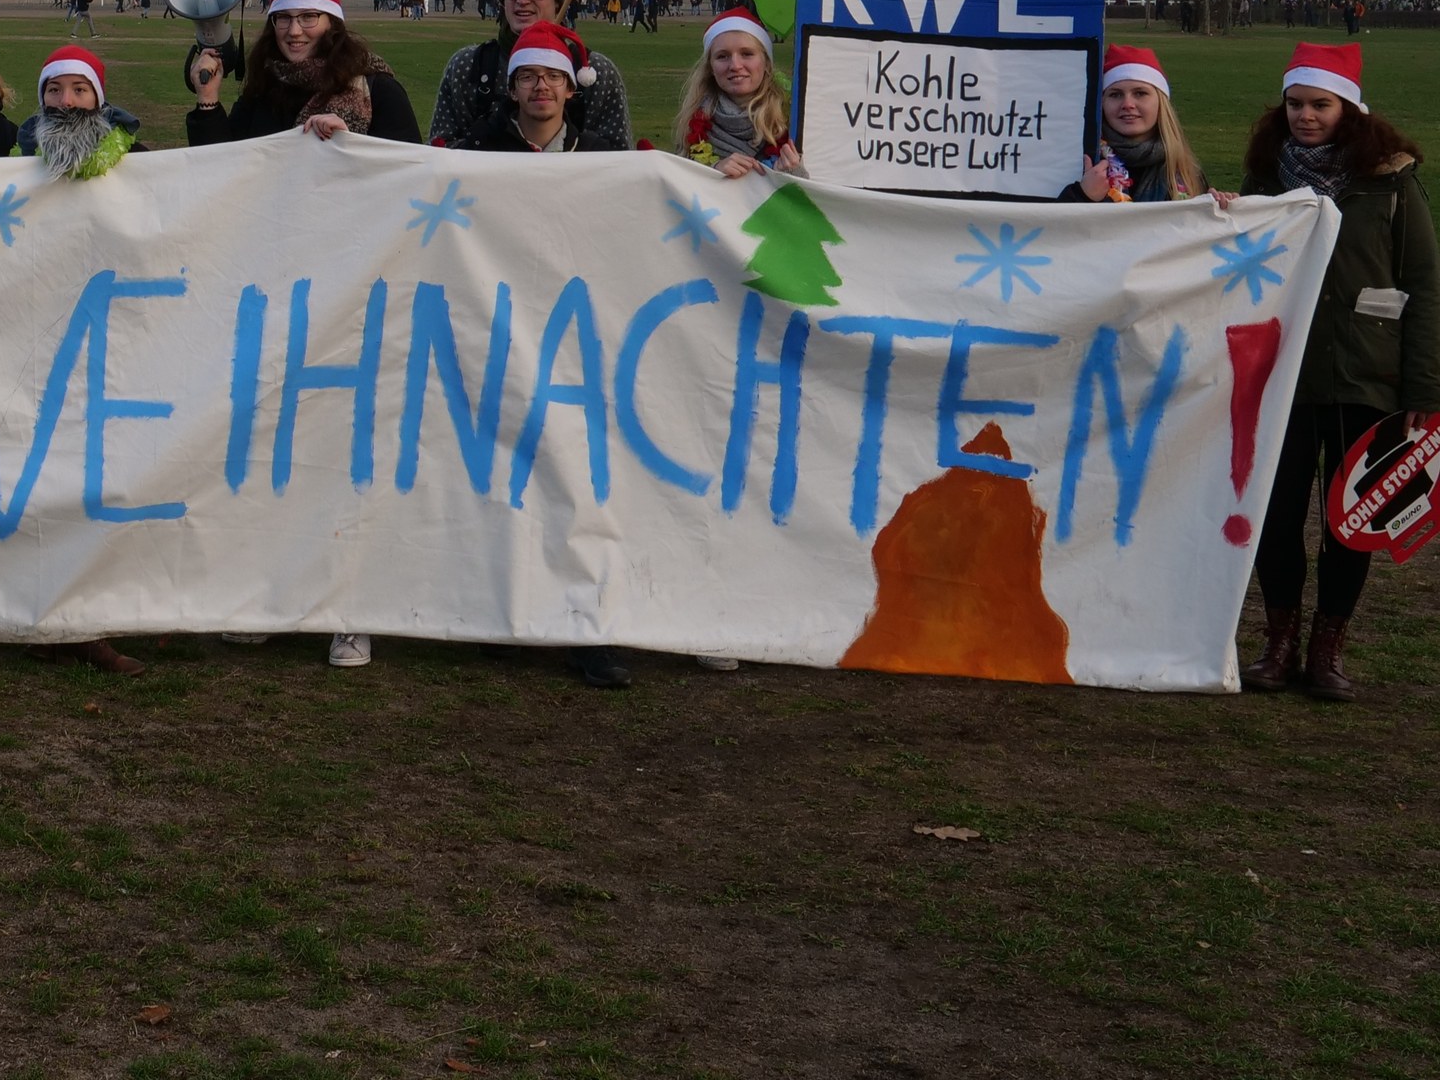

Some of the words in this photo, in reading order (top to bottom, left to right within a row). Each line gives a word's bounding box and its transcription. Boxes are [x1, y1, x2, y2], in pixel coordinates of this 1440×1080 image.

[875, 50, 982, 101] Kohle
[843, 100, 1048, 140] verschmutzt
[857, 139, 960, 170] unsere
[967, 138, 1021, 174] Luft
[1338, 489, 1386, 540] KOHLE
[1400, 504, 1422, 525] BUND
